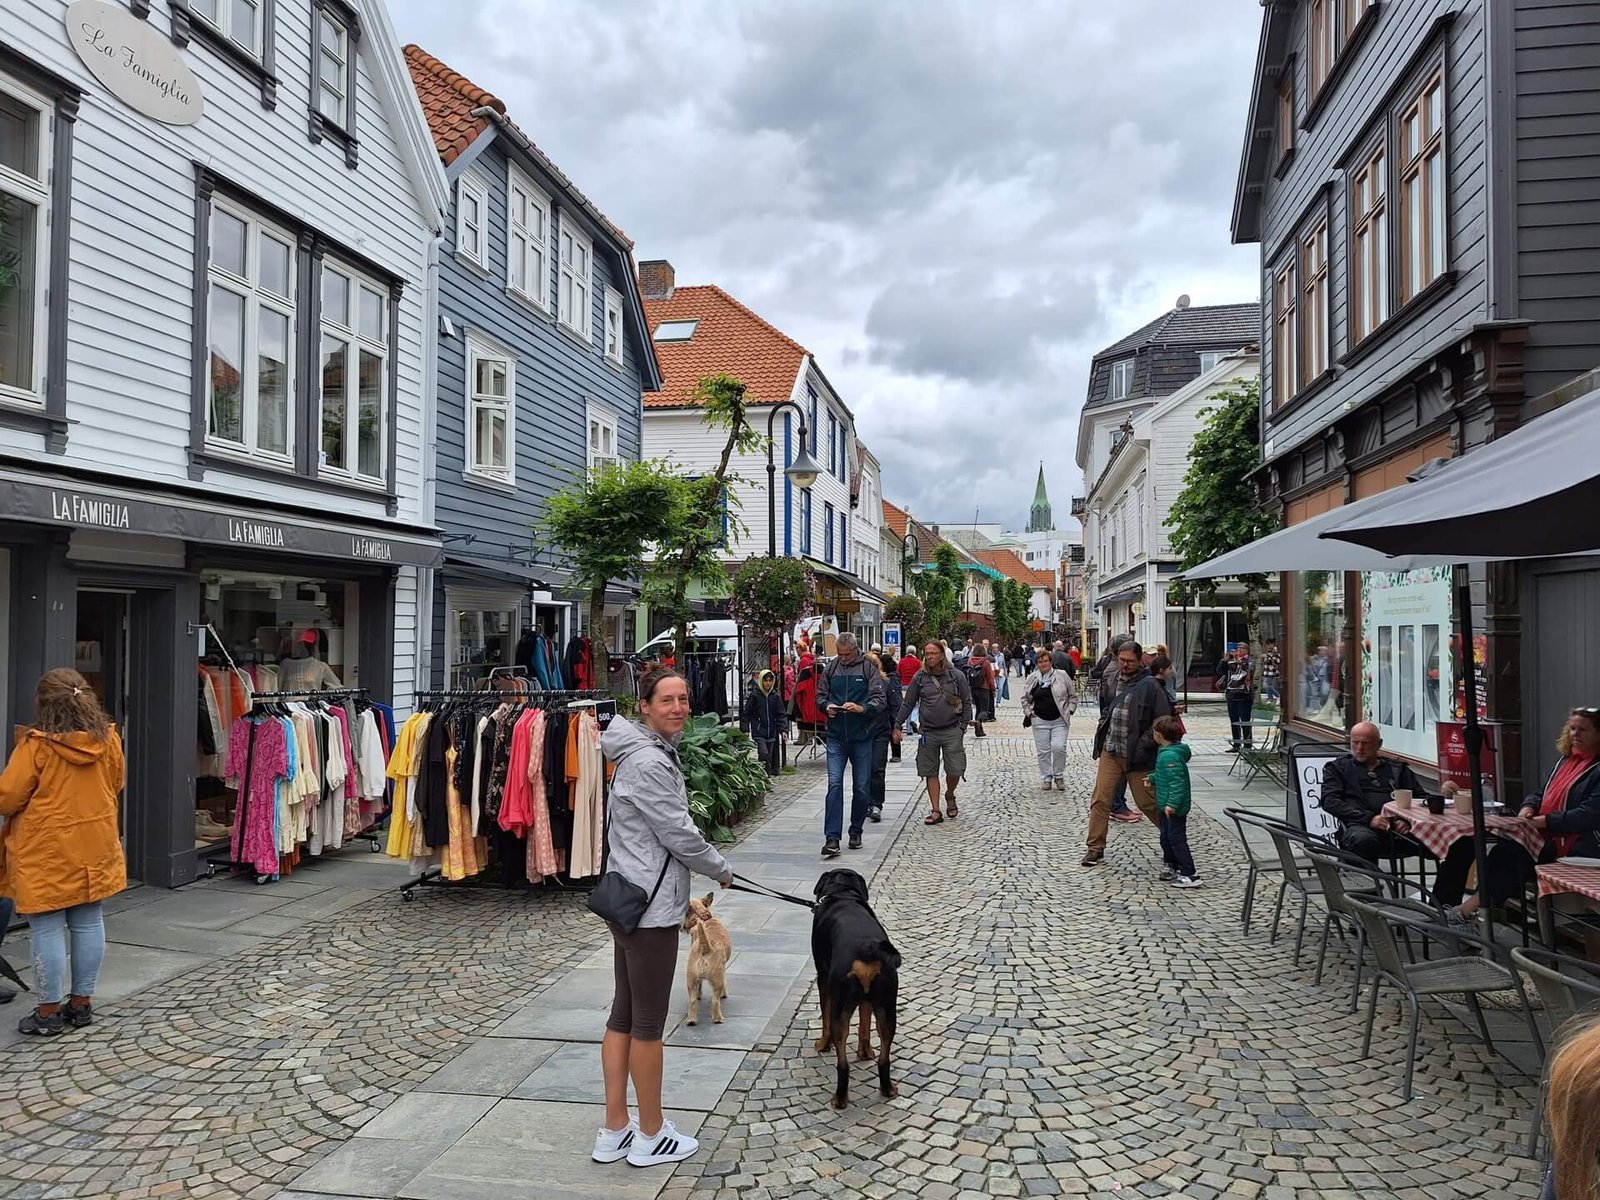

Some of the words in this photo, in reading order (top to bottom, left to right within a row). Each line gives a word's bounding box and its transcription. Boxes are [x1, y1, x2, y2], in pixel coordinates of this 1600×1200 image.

[81, 23, 116, 58] La
[120, 45, 191, 106] Famiglia
[52, 491, 72, 521] LA
[73, 494, 129, 529] FAMIGLIA
[229, 518, 243, 542] LA
[243, 520, 285, 547] FAMIGLIA
[351, 536, 361, 557] LA
[361, 538, 392, 561] FAMIGLIA
